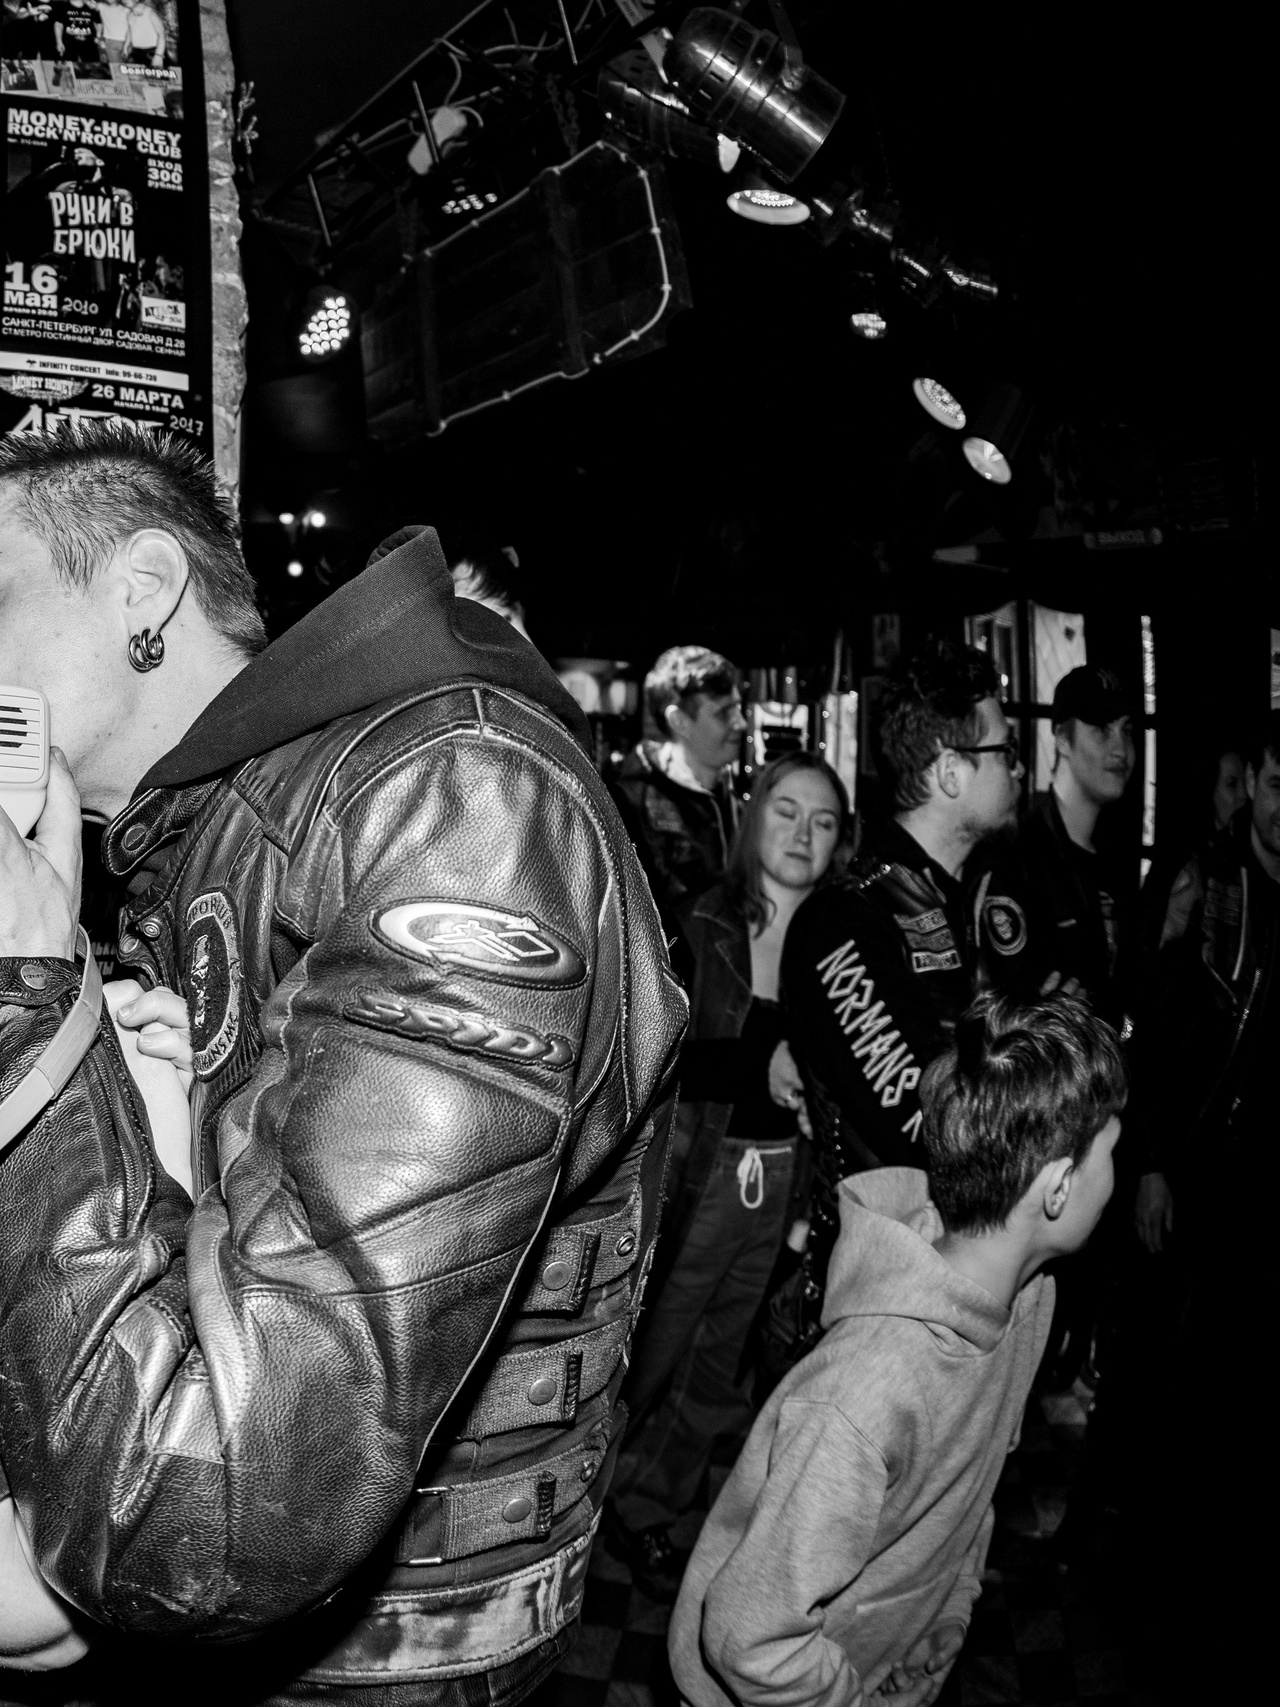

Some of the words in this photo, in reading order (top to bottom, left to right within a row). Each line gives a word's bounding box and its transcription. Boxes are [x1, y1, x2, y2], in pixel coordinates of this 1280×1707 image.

[7, 107, 182, 148] MONEY-HONEY
[7, 122, 128, 150] ROCK'N'ROLL
[136, 140, 182, 159] CLUB
[147, 158, 183, 173] ВХОД
[147, 168, 183, 184] 300
[53, 227, 136, 264] БРЮКИ
[4, 261, 59, 294] 16
[61, 297, 99, 315] 2010
[2, 316, 97, 335] САНКТ-ПЕТЕРБУРГ
[117, 330, 164, 344] САДОВАЯ
[43, 330, 91, 344] ГОСТИННЫЙ
[155, 345, 186, 357] СЕННАЯ
[39, 361, 68, 371] INFINITY
[70, 364, 101, 375] CONCERT
[11, 375, 43, 390] MONEY
[45, 377, 74, 395] HONEY
[92, 384, 115, 399] 26
[120, 387, 184, 409] МАРТА
[114, 400, 144, 410] НАЧАЛО
[170, 415, 204, 436] 2017
[817, 938, 921, 1108] NORMANS
